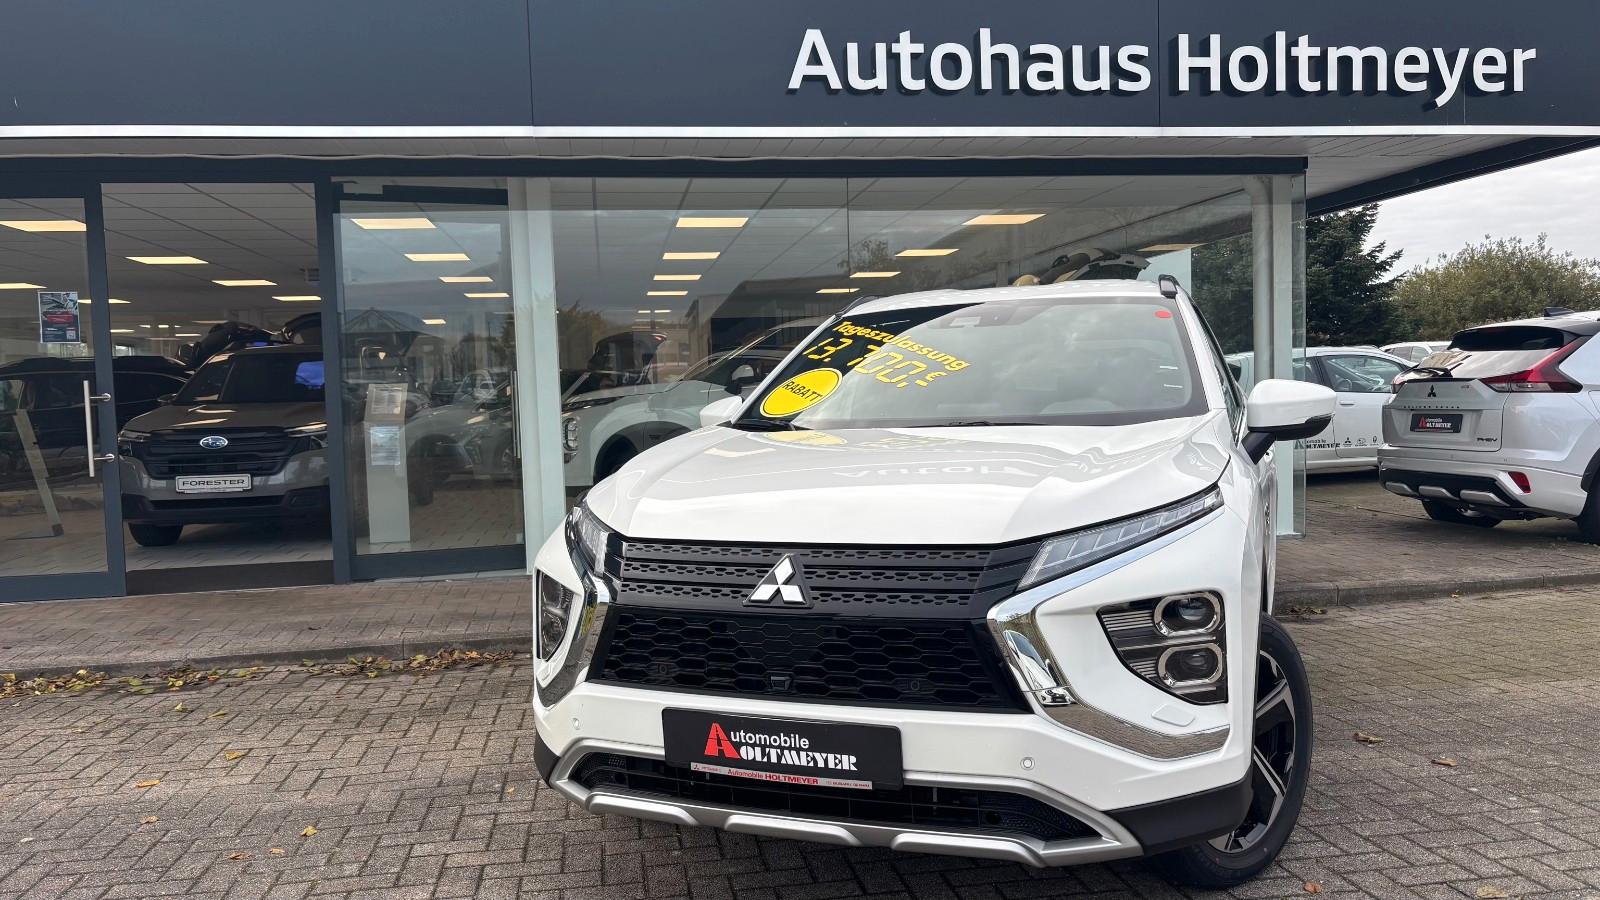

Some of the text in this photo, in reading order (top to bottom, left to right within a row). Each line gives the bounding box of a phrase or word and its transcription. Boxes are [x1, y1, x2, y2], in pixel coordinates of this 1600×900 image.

[787, 27, 1537, 108] Autohaus Holtmeyer
[832, 320, 972, 372] Tageszulassung
[781, 379, 824, 403] RABATT
[182, 478, 245, 487] FORESTER
[704, 720, 810, 760] Automobile
[727, 769, 764, 780] Automobile
[764, 773, 819, 785] HOLTMEYER
